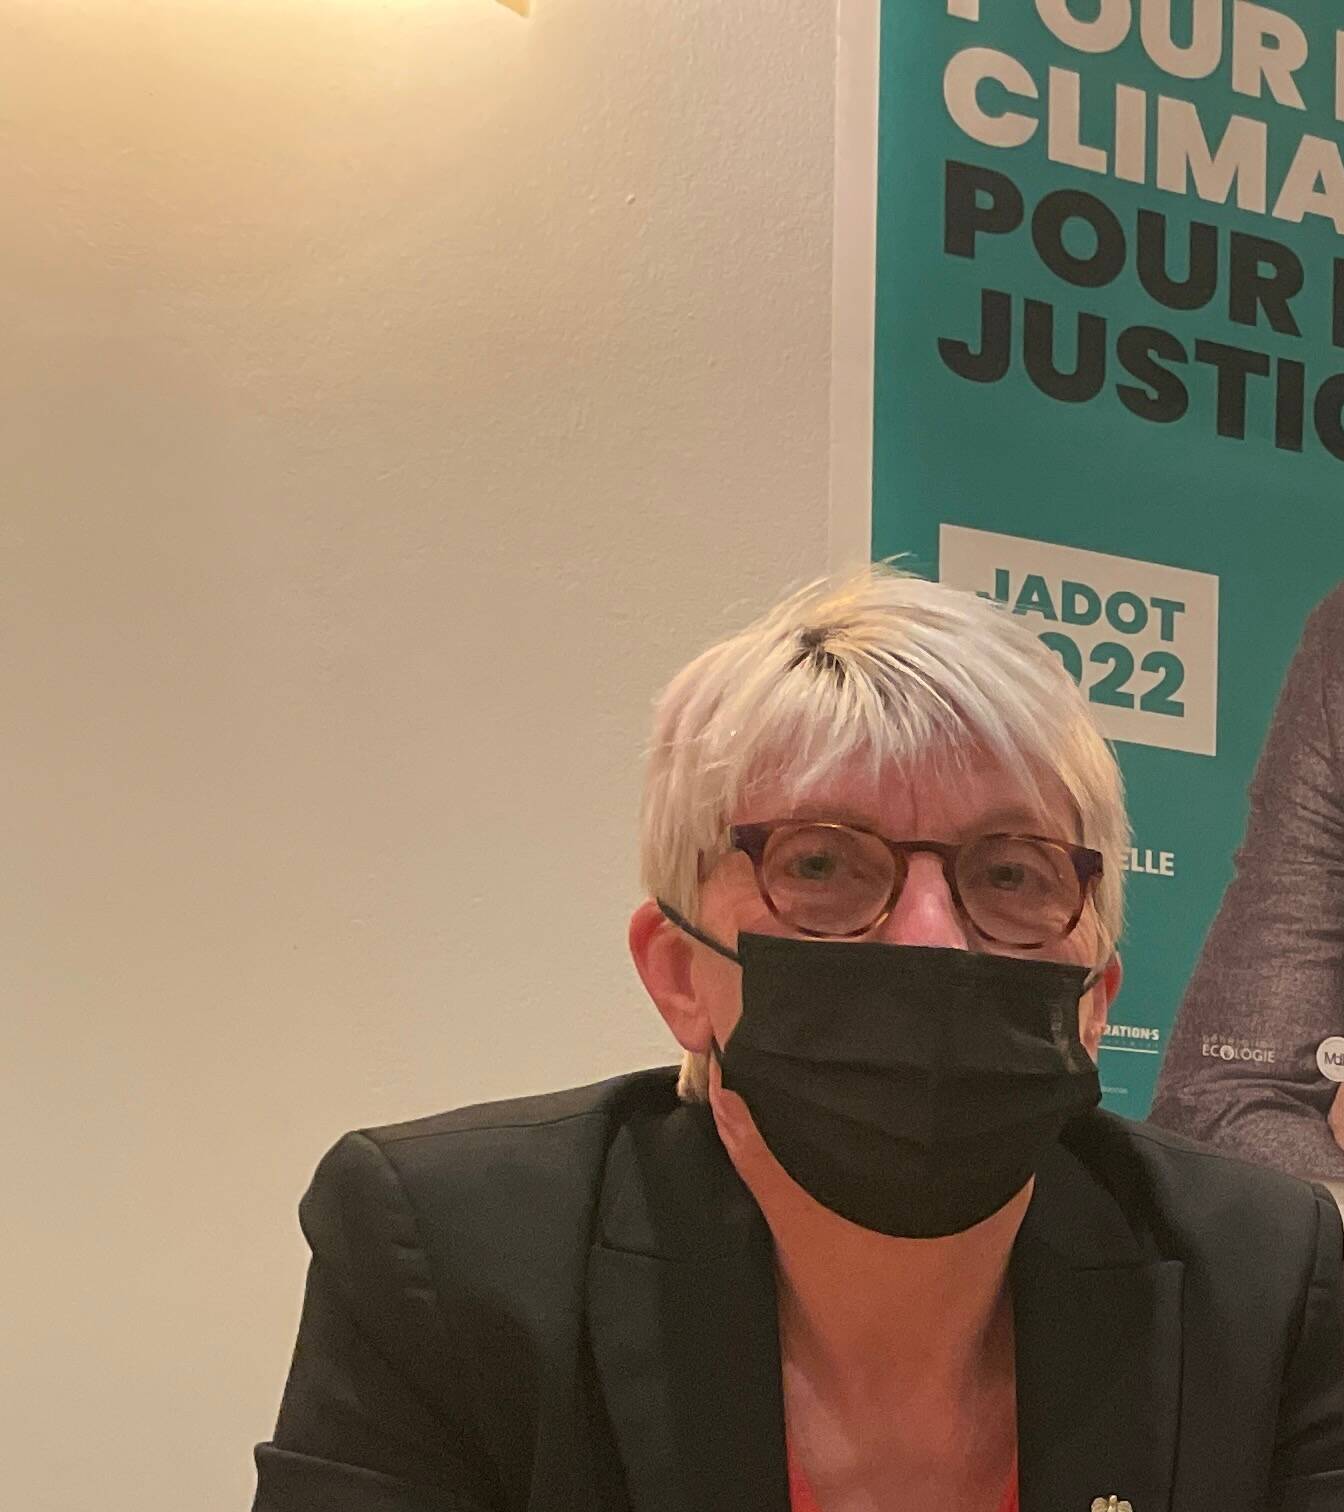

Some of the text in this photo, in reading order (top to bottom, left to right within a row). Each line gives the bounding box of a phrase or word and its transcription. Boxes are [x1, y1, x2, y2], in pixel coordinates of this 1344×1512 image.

[947, 0, 1307, 110] OUR
[944, 160, 1304, 337] POUR
[976, 568, 1185, 642] JADOT
